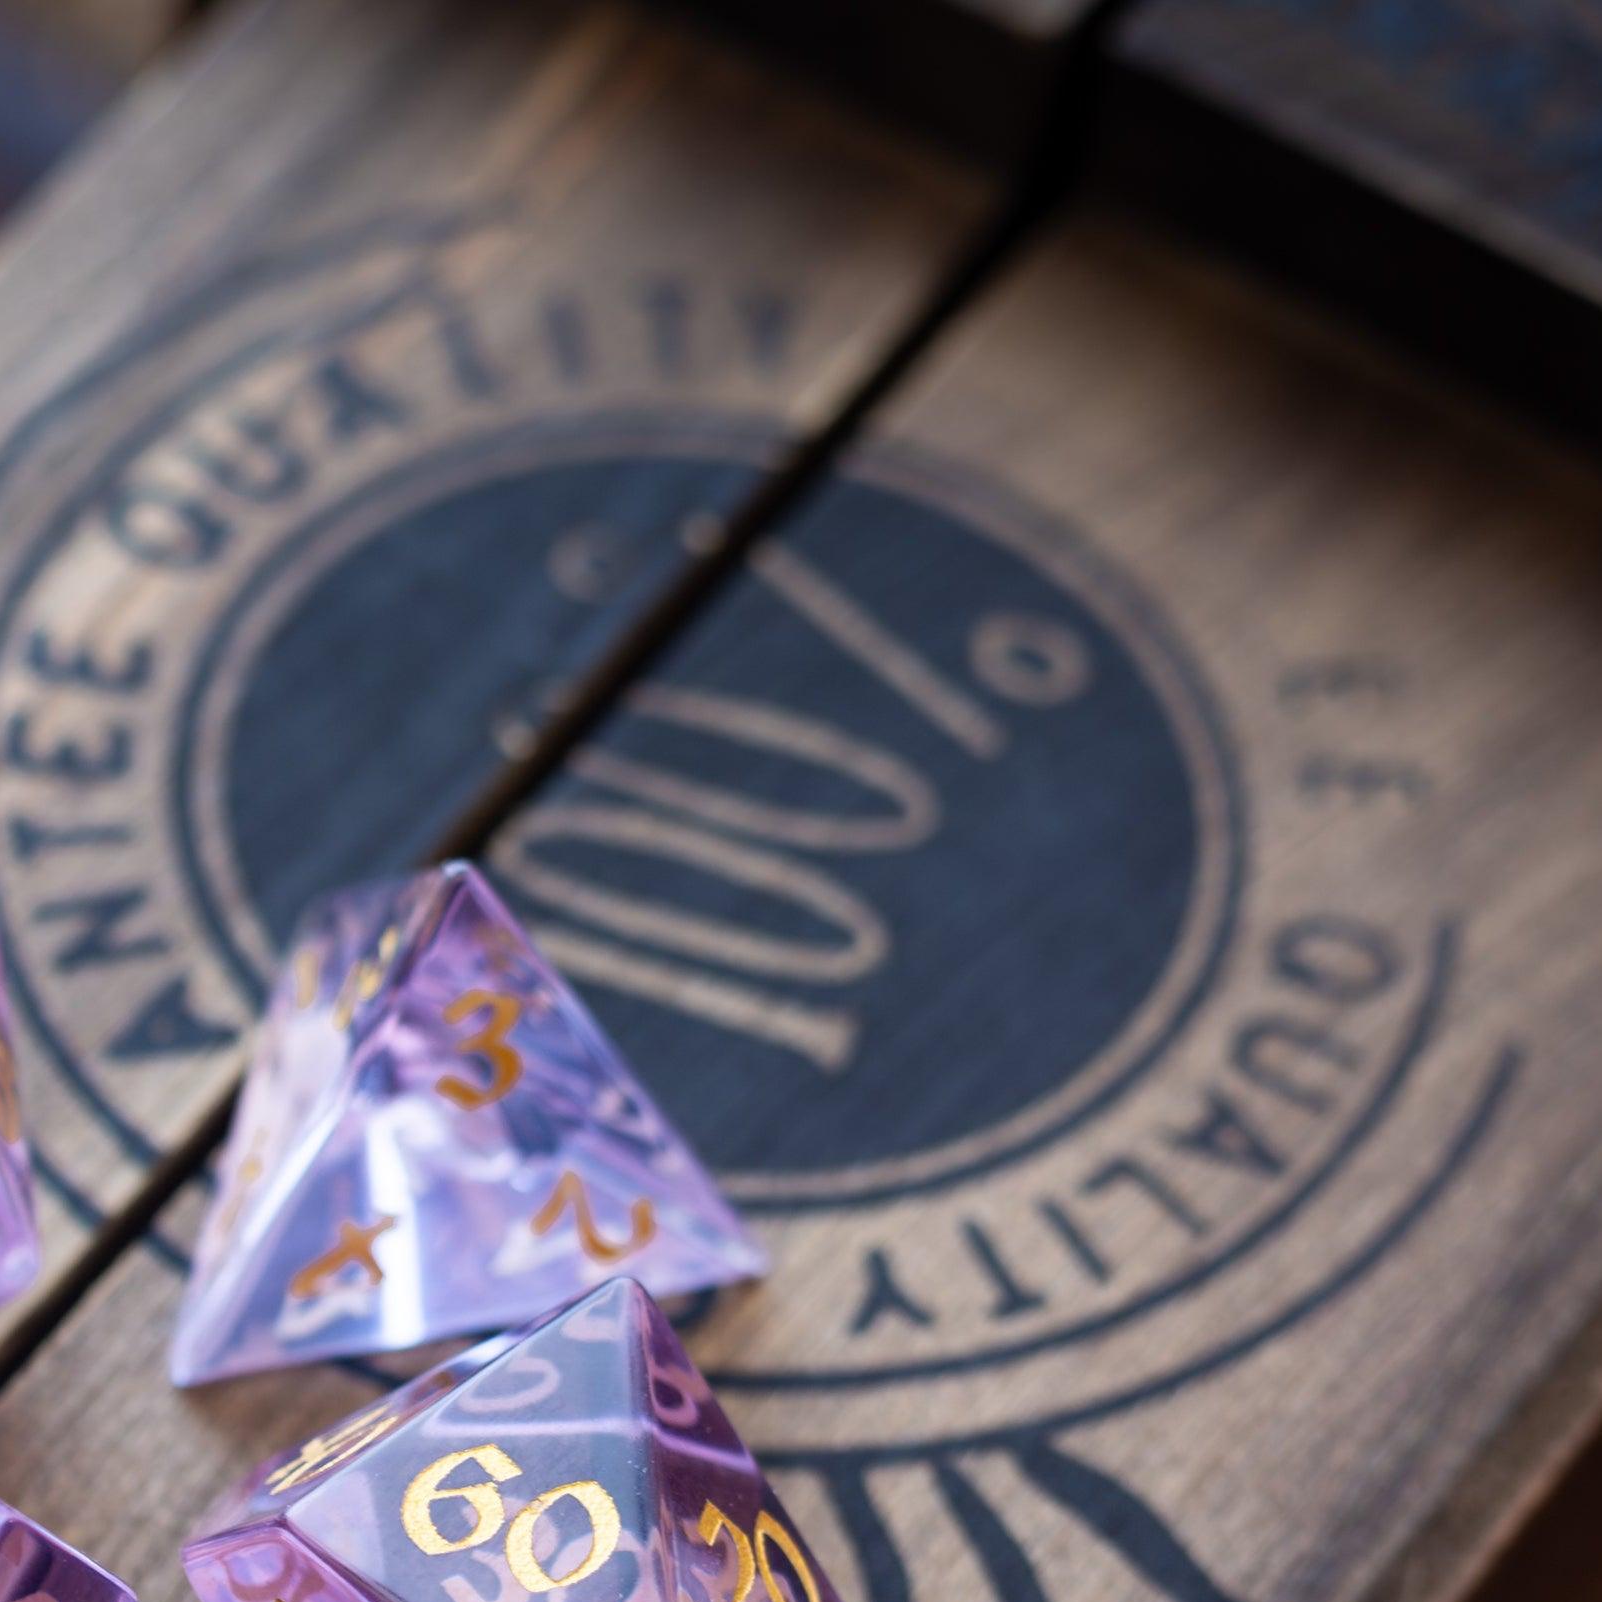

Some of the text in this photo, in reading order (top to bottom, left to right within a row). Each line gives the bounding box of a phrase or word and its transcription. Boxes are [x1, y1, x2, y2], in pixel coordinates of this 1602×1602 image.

[434, 988, 523, 1112] 3
[848, 908, 1398, 1338] QUALITY
[401, 1442, 621, 1593] 60
